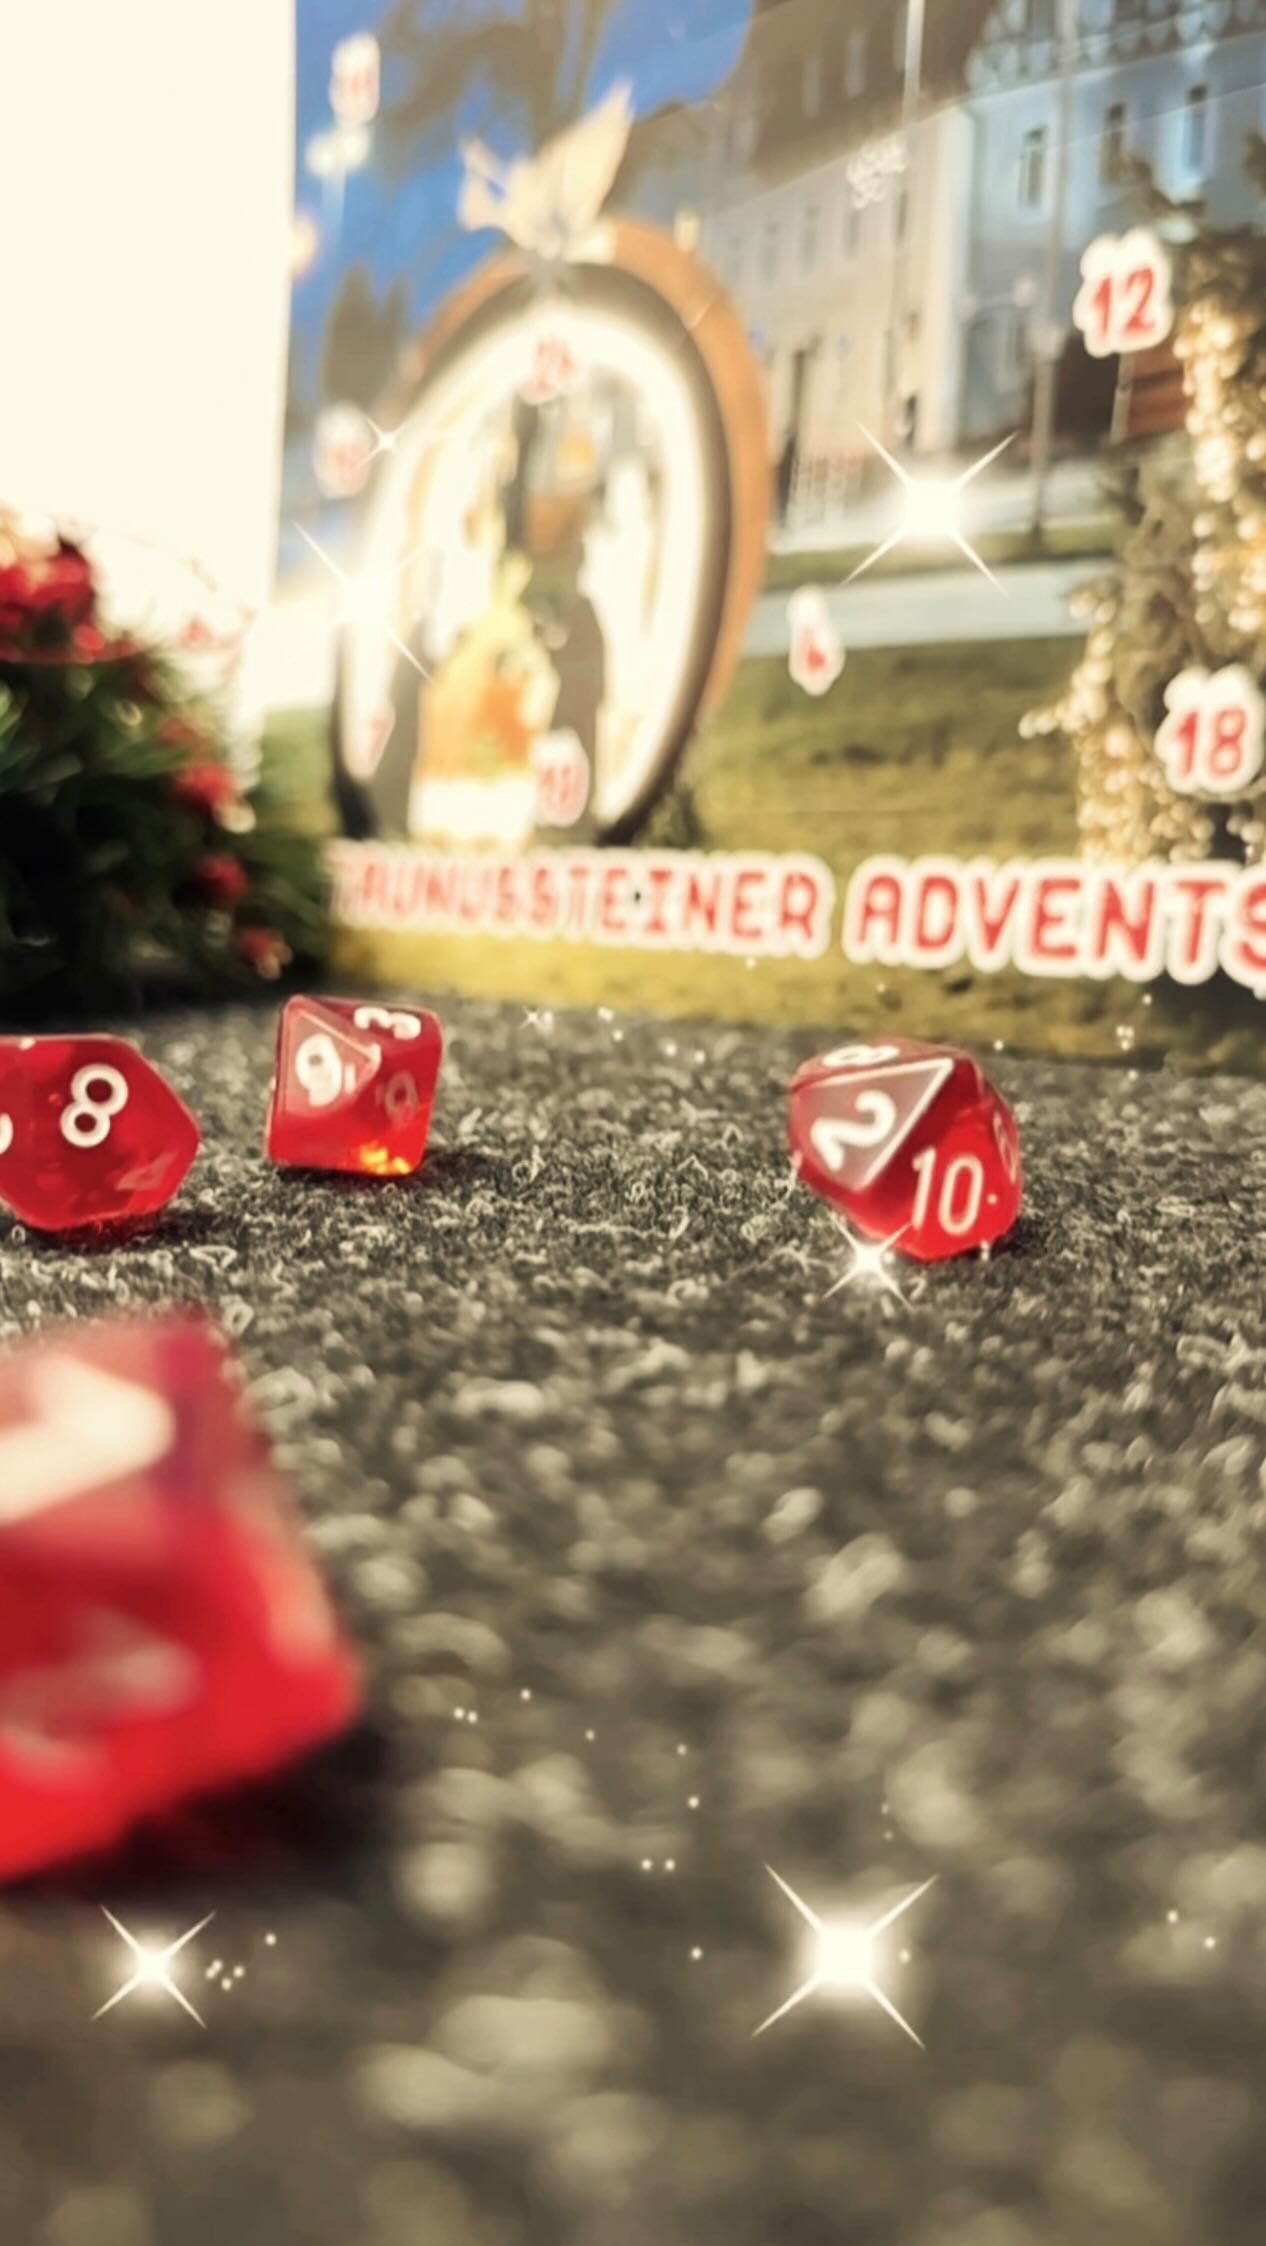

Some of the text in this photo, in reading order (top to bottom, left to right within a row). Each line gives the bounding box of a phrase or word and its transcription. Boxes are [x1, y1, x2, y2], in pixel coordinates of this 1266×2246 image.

[1090, 266, 1156, 342] 12
[1174, 706, 1246, 779] 18
[60, 1064, 129, 1147] 8
[810, 1089, 896, 1173] 2
[912, 1145, 984, 1236] 10
